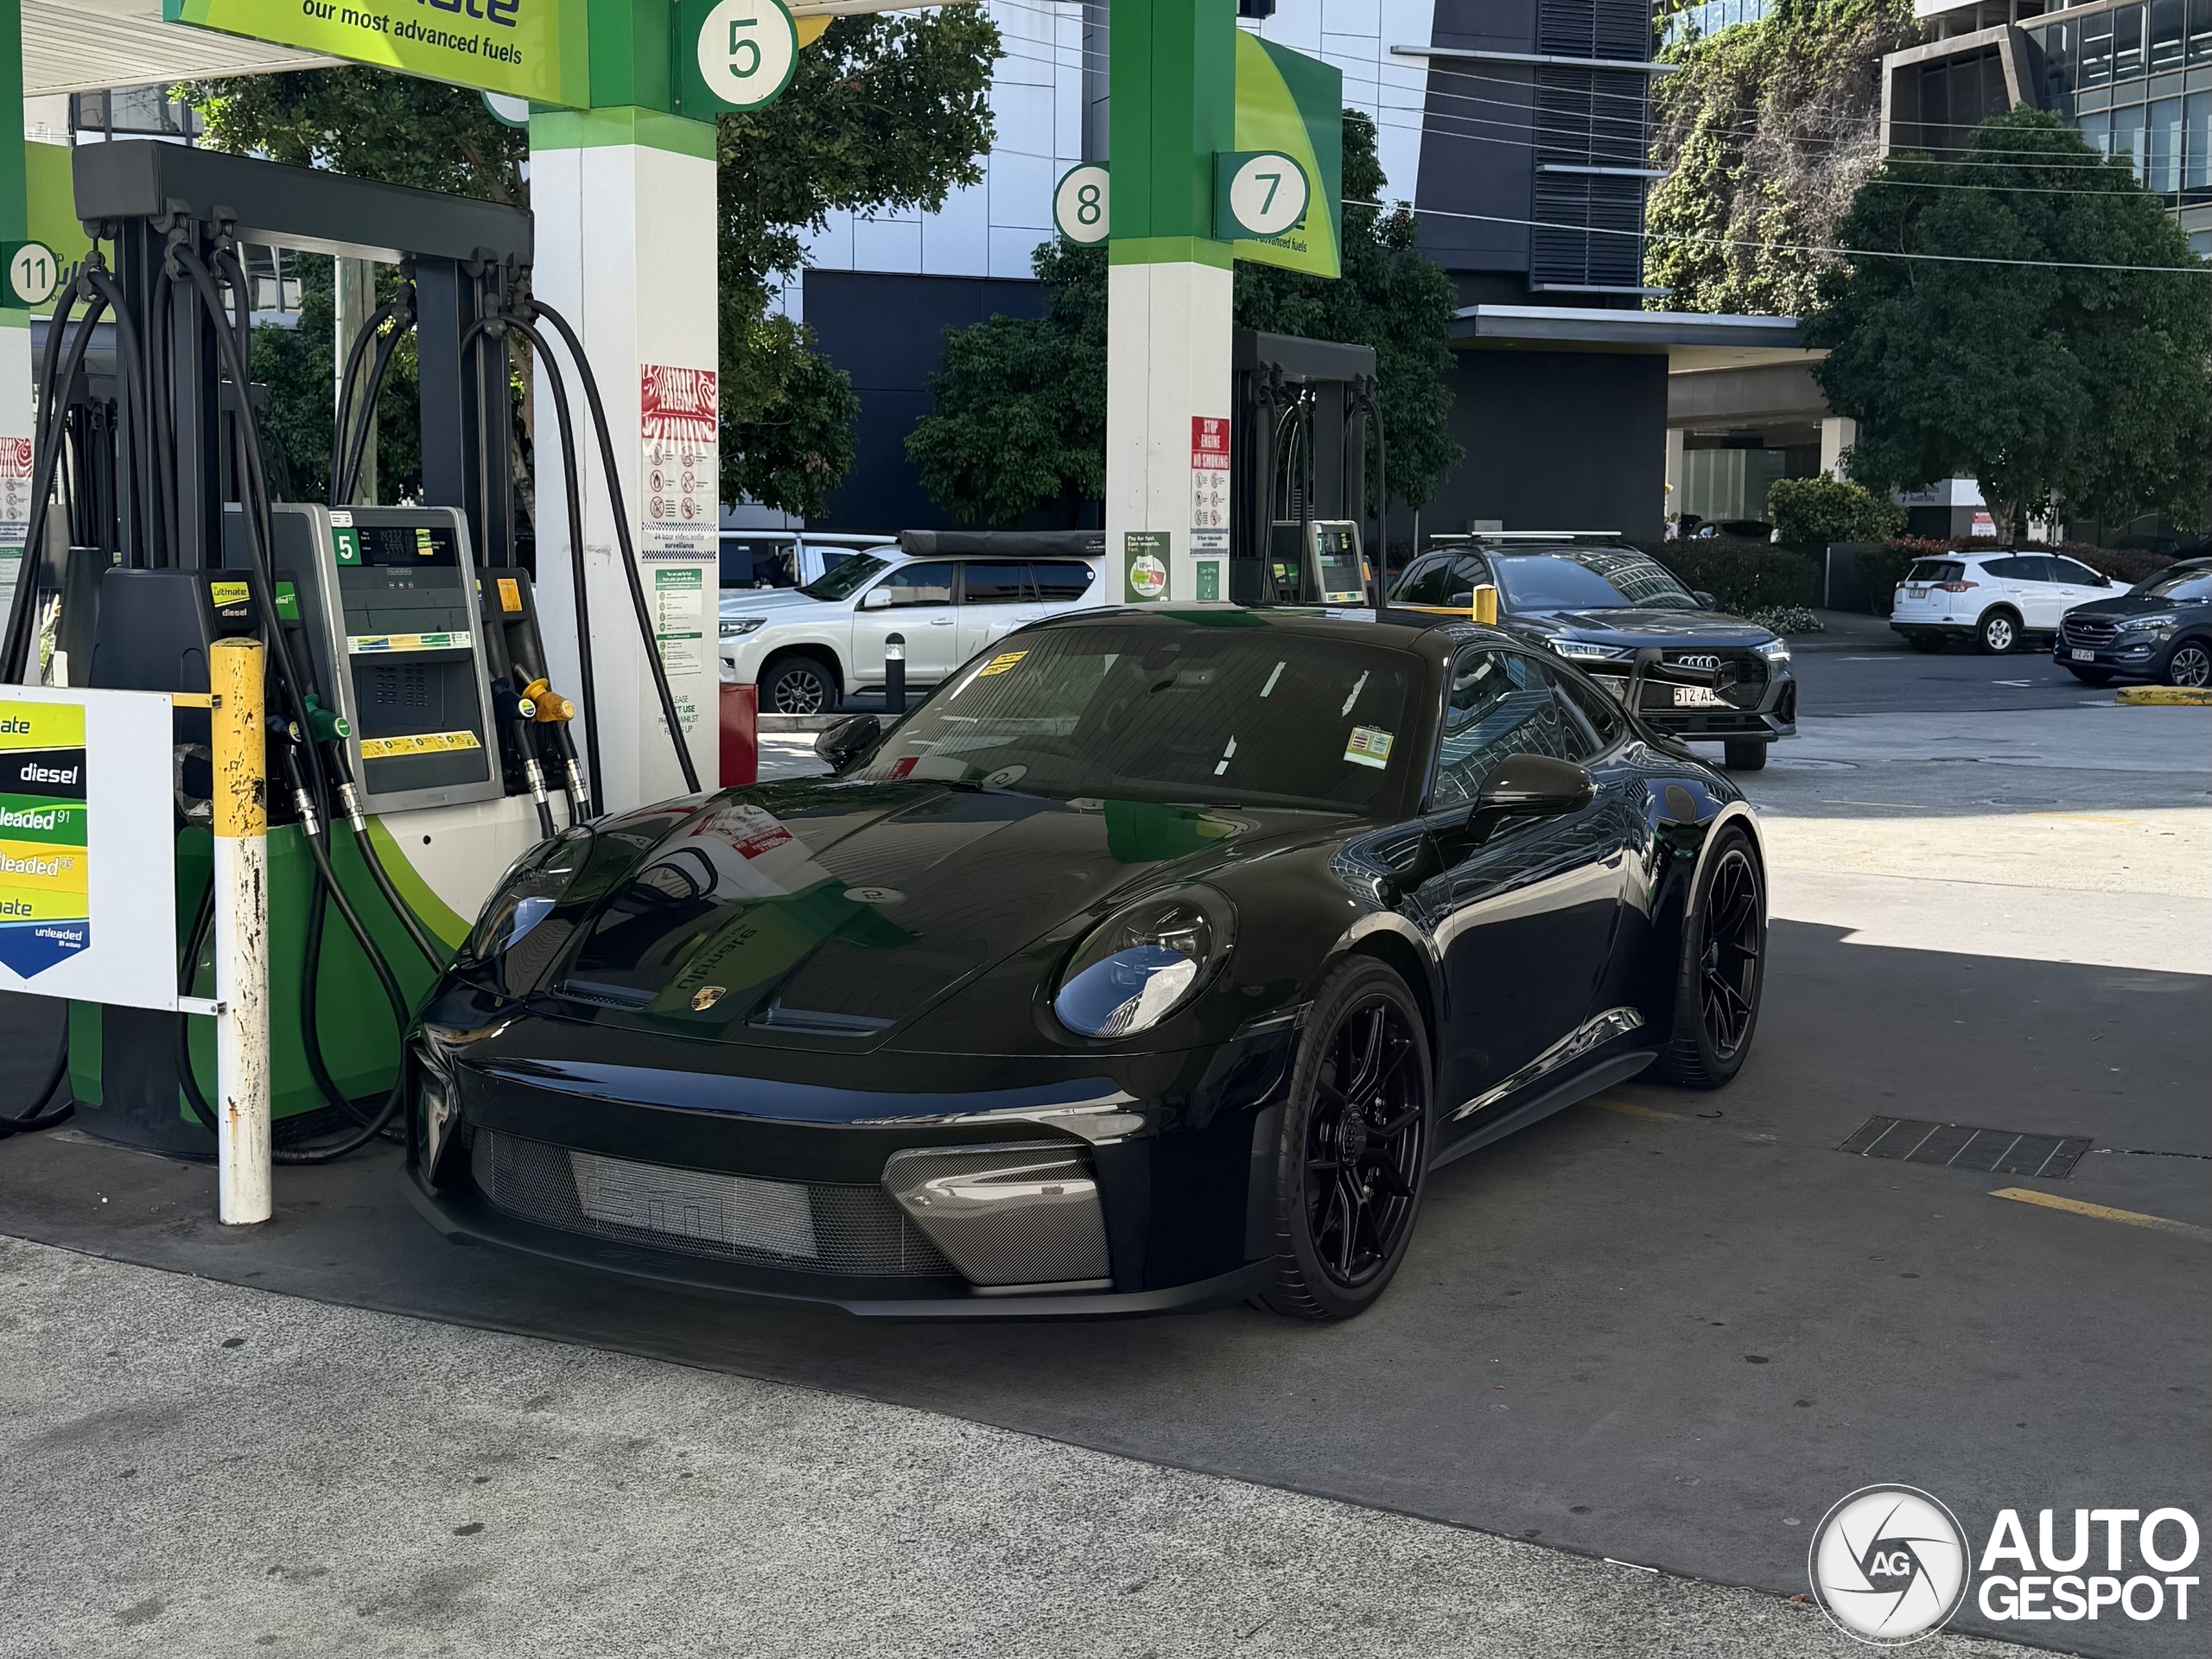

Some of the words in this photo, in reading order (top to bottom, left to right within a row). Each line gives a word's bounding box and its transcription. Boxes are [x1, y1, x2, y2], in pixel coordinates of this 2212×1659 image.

[302, 0, 336, 20] our
[340, 9, 390, 34] most
[394, 19, 479, 54] advanced
[482, 37, 523, 65] fuels
[729, 18, 761, 79] 5
[1255, 174, 1281, 215] 7
[1077, 184, 1102, 226] 8
[1292, 238, 1307, 253] fuels
[21, 257, 46, 289] 11
[1204, 419, 1218, 434] STOP
[1201, 434, 1220, 448] ENGINE
[1193, 454, 1201, 467] NO
[1202, 454, 1228, 468] SMOKING
[339, 535, 353, 559] 5
[222, 608, 247, 617] diesel
[683, 704, 696, 713] USE
[685, 725, 693, 734] UP
[20, 762, 79, 785] diesel
[0, 849, 60, 877] leaded
[35, 927, 83, 941] unleaded
